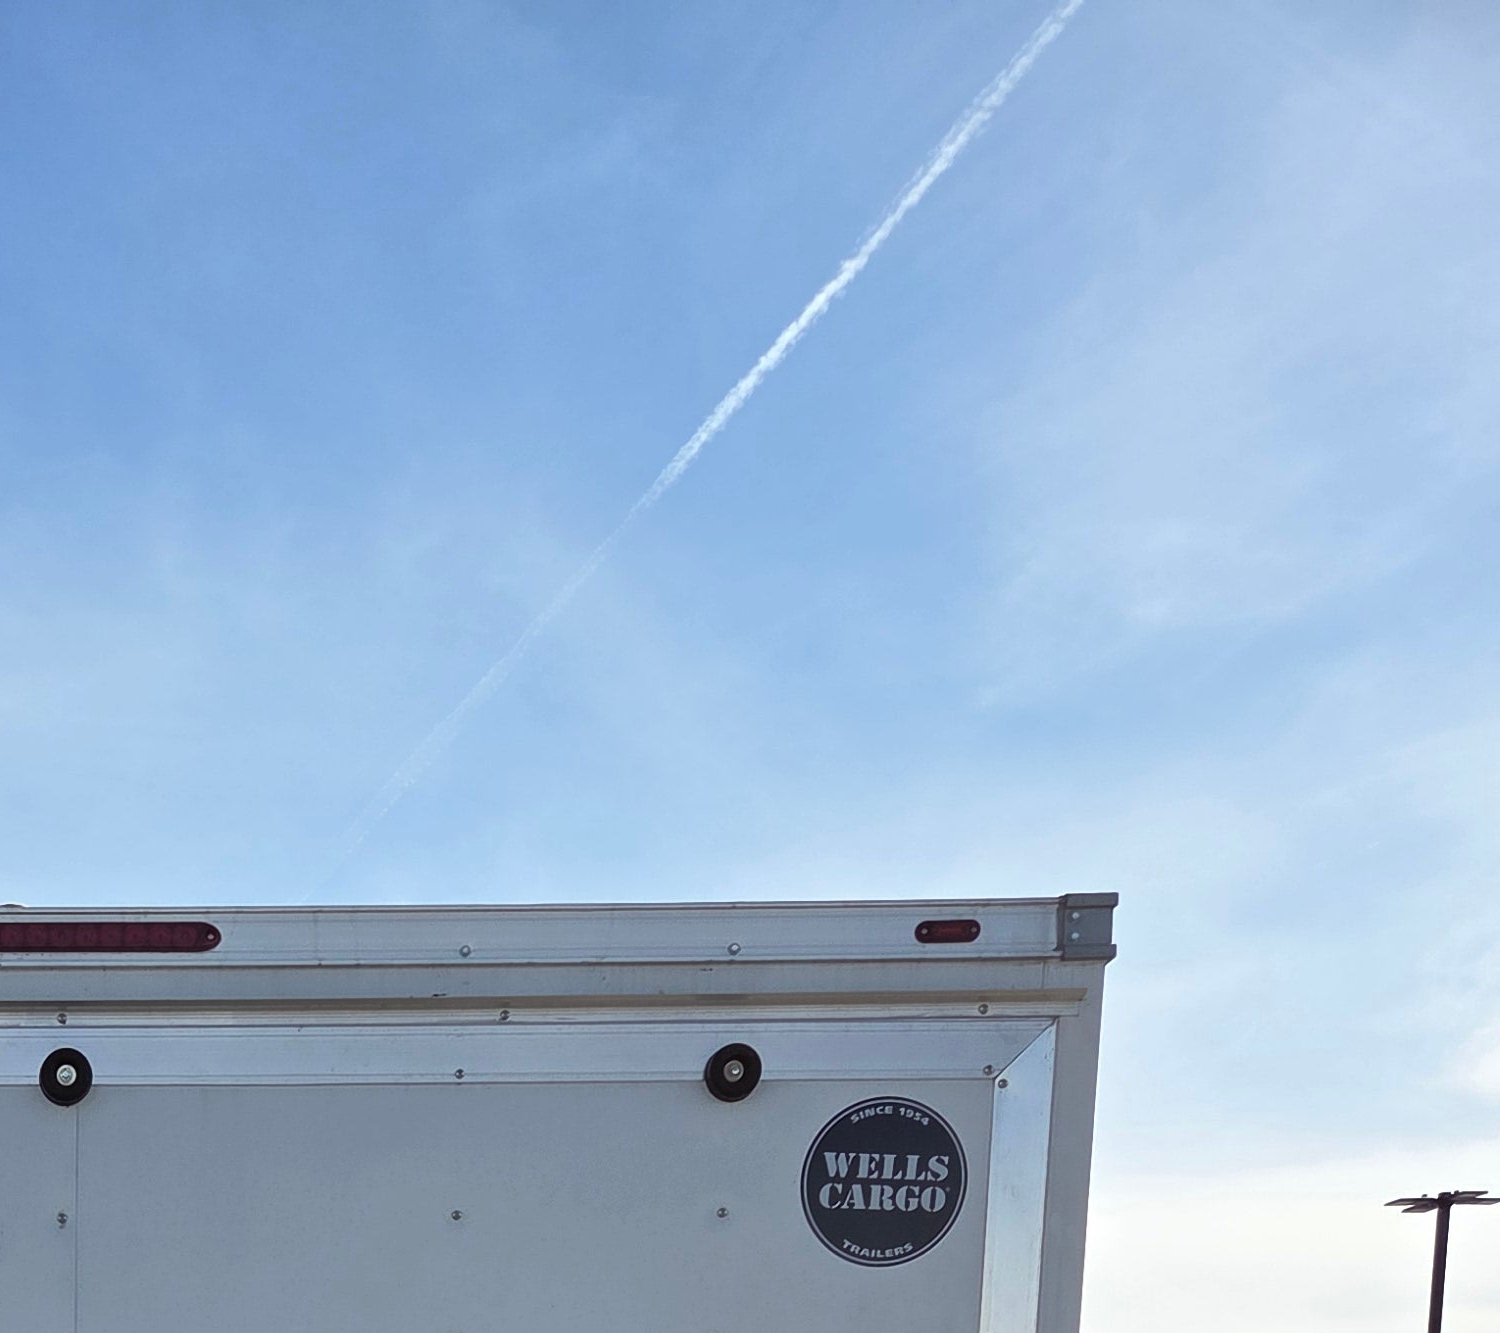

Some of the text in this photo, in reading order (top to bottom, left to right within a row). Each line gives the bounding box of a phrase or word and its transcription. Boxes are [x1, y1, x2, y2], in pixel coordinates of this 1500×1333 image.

[850, 1105, 930, 1126] SINCE 1954
[823, 1151, 950, 1182] WELLS
[818, 1182, 947, 1213] CARGO
[842, 1238, 914, 1258] TRAILERS
